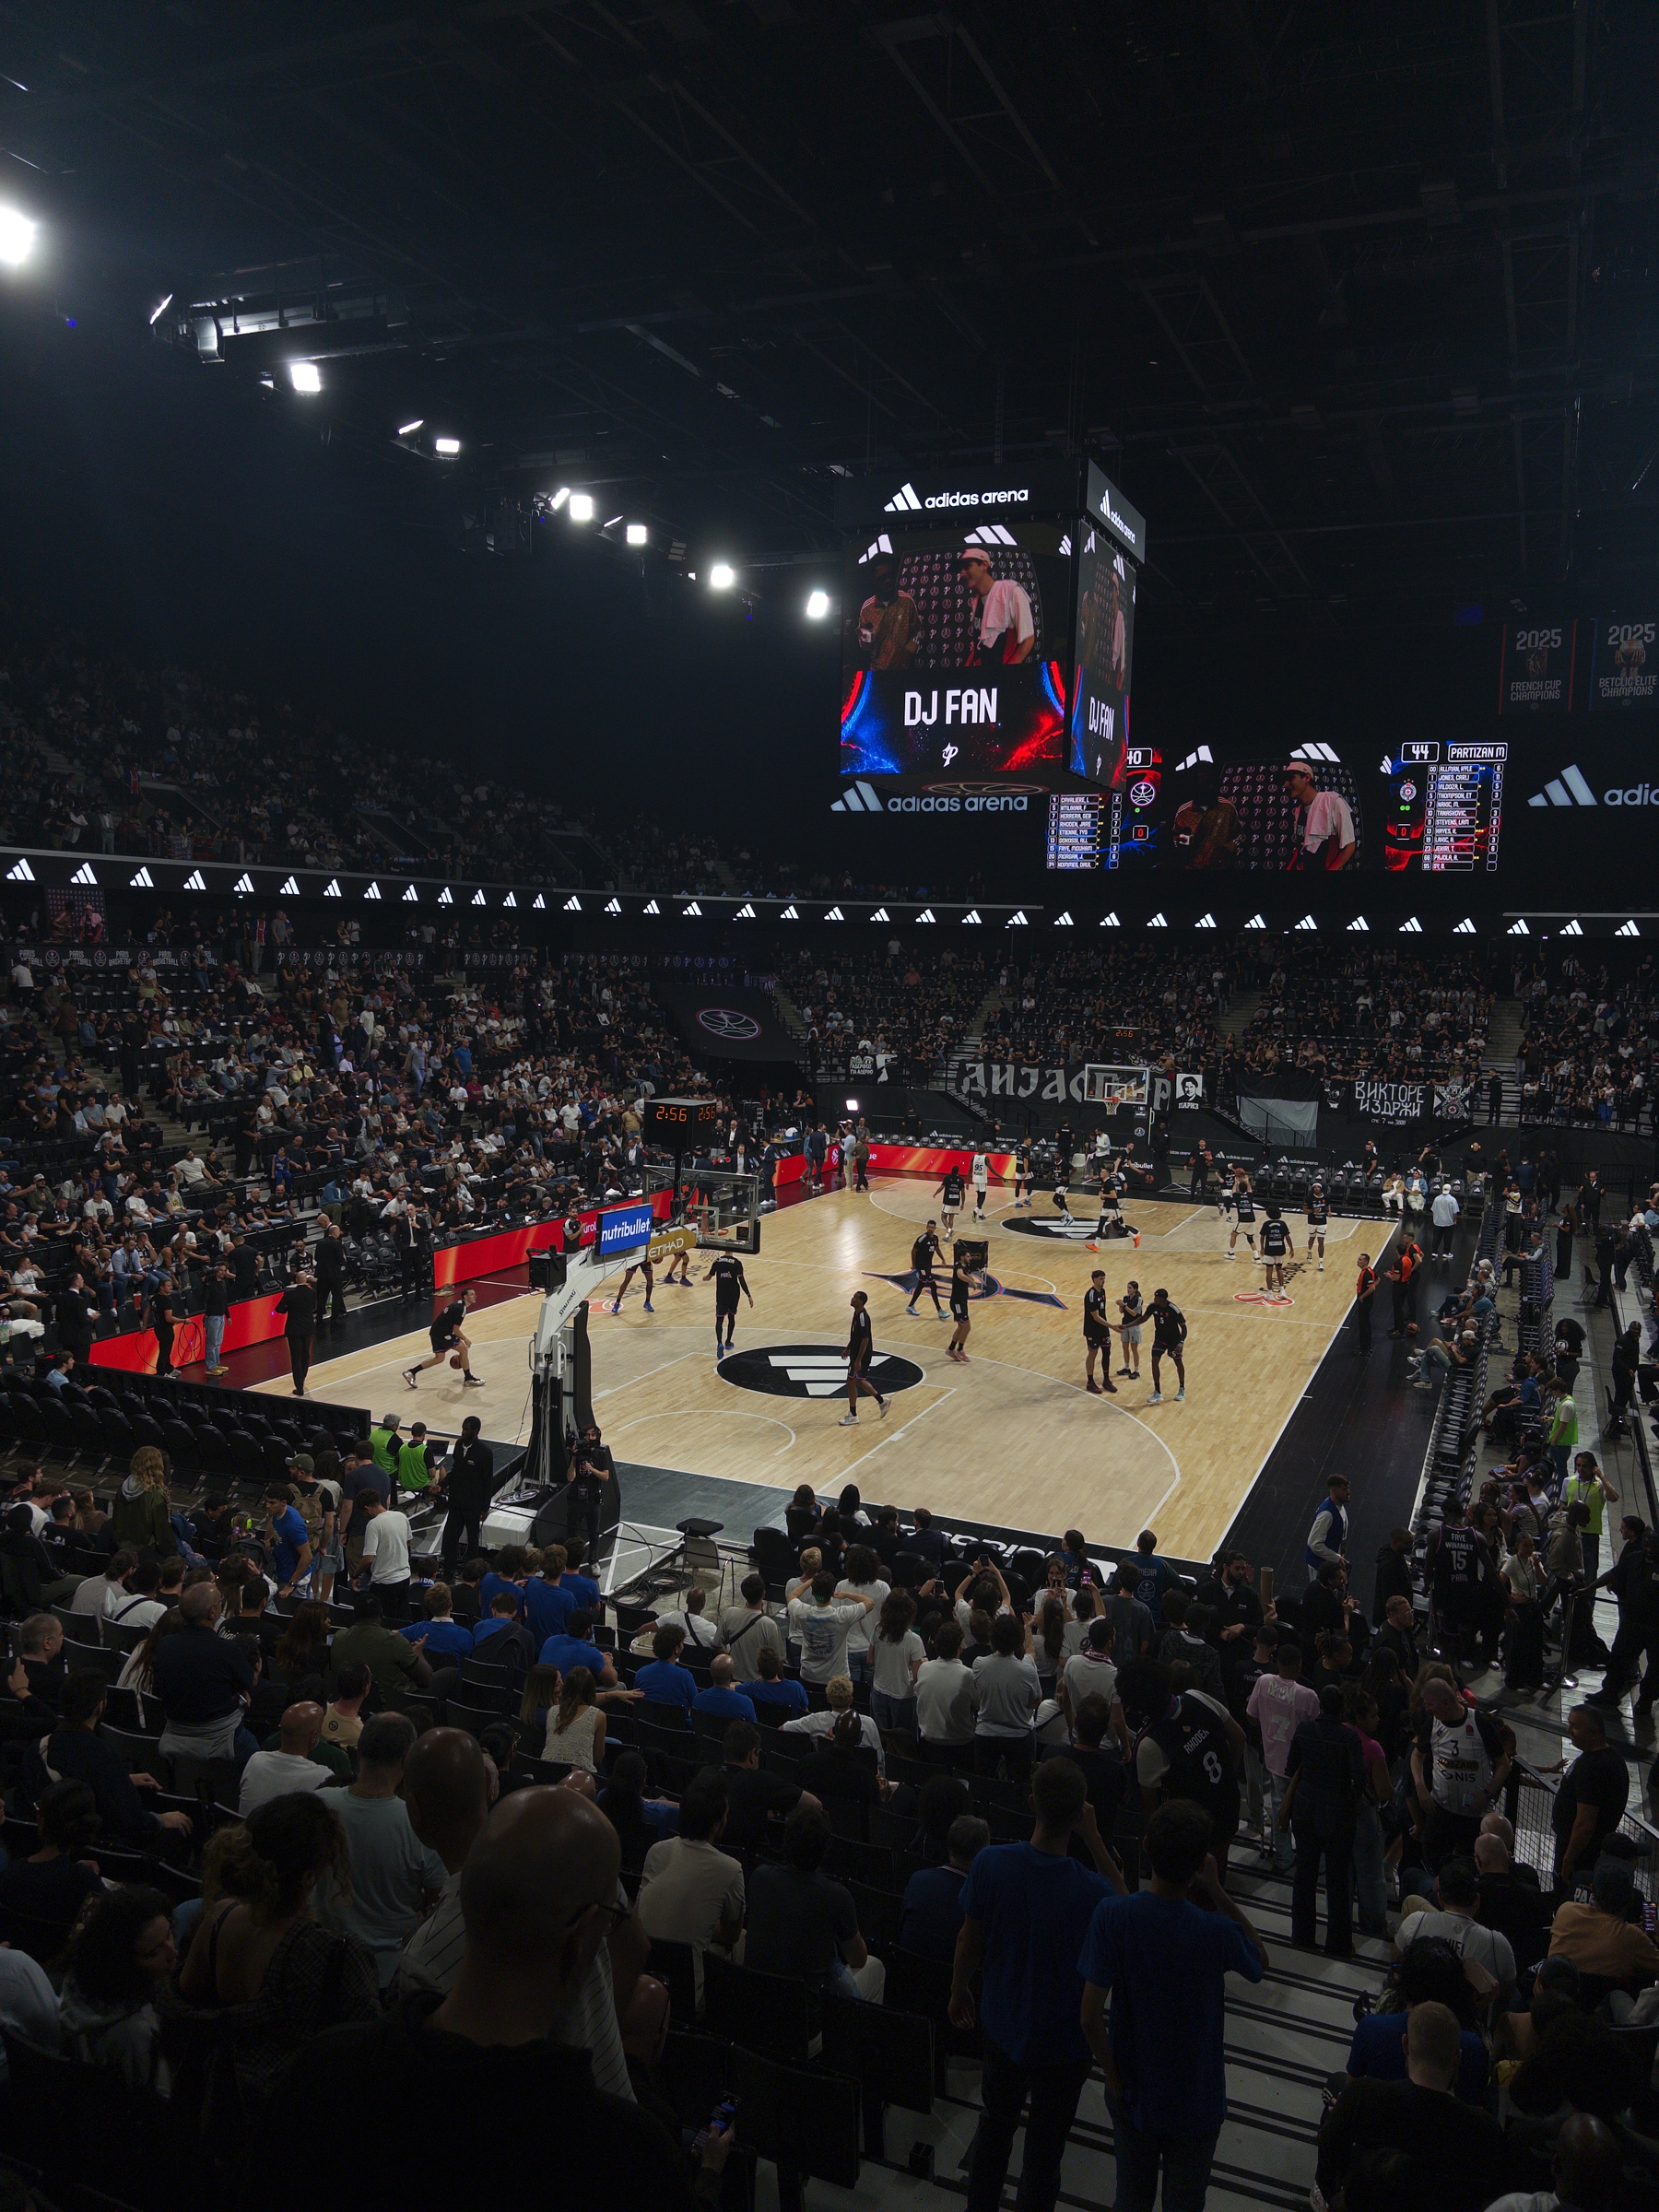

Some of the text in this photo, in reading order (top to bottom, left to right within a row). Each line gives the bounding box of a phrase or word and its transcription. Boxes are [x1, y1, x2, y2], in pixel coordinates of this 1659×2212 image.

[924, 488, 1029, 509] adidas arena
[1111, 511, 1135, 544] adidas arena
[1516, 629, 1561, 651] 2025
[1607, 623, 1655, 645] 2025
[1511, 680, 1561, 691] FRENCH CUP
[1599, 677, 1633, 688] BETCLIC
[1511, 689, 1560, 701] CHAMPIONS
[1601, 686, 1653, 698] CHAMPIONS
[904, 688, 997, 726] DJ FAN
[1088, 696, 1114, 741] DJ FAN
[1412, 745, 1429, 759] 44
[1451, 747, 1505, 759] PARTIZAN M
[888, 796, 1028, 812] adidas arena
[1115, 1029, 1134, 1038] 2:56
[1355, 1081, 1427, 1103] ВИКТОРЕ
[655, 1106, 688, 1122] 2:56
[698, 1106, 715, 1121] 2:56
[1359, 1099, 1420, 1117] ИЗДРЖИ
[649, 1237, 684, 1258] ETIHAD
[1445, 1542, 1474, 1551] WINAMAX
[1451, 1550, 1466, 1571] 15
[1451, 1740, 1459, 1757] 3
[1203, 1751, 1222, 1784] 8
[1455, 1771, 1476, 1783] NIS
